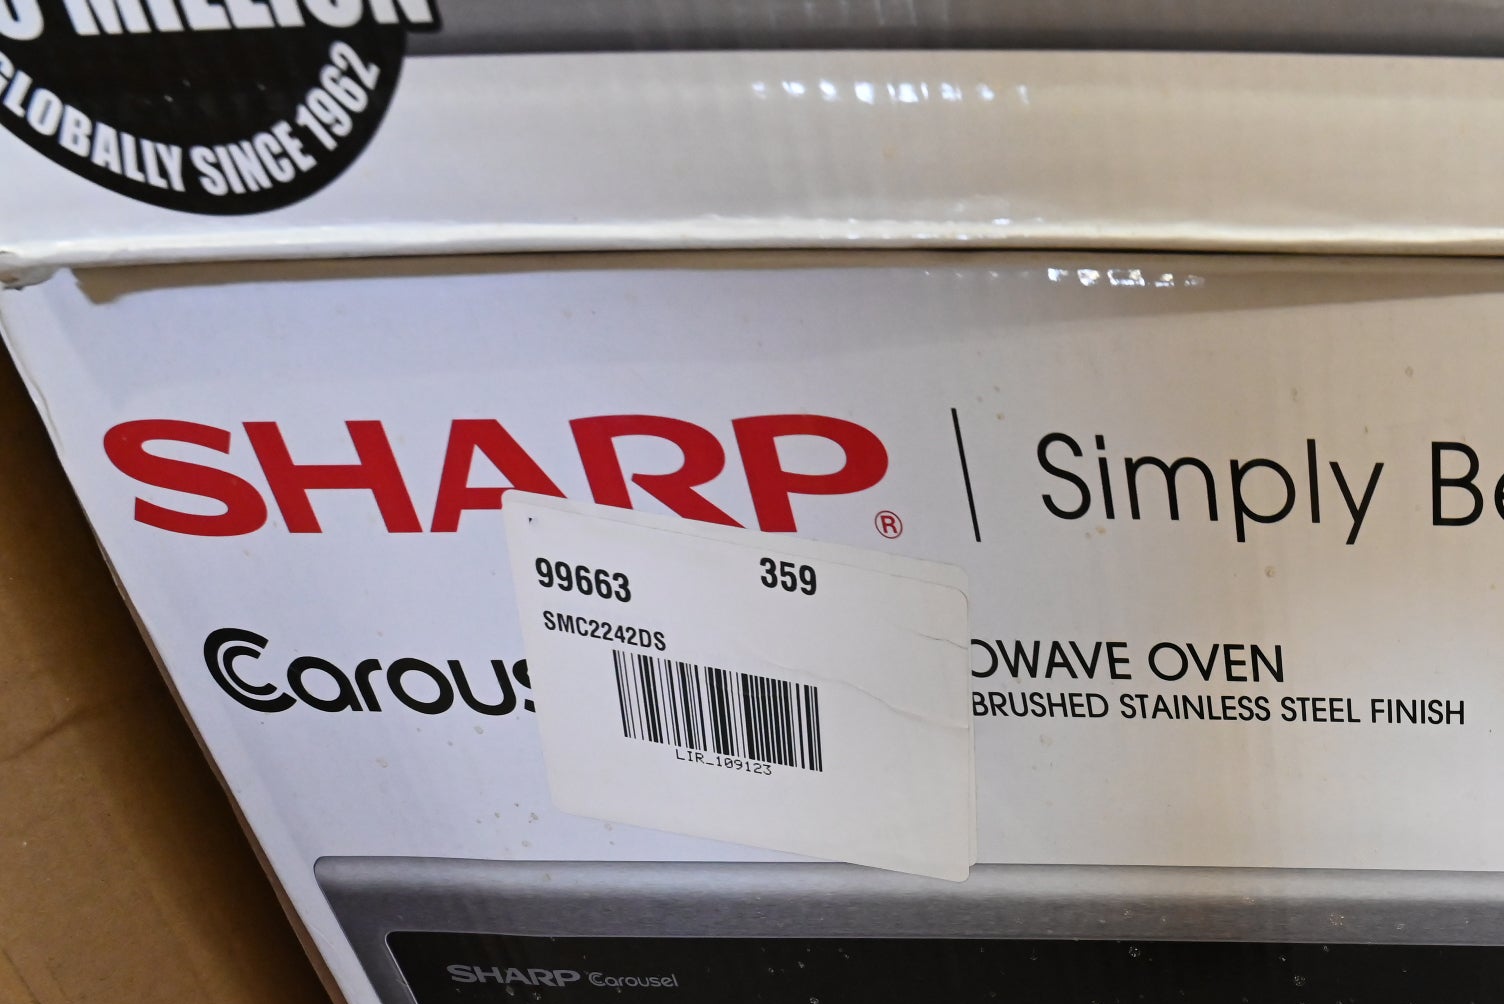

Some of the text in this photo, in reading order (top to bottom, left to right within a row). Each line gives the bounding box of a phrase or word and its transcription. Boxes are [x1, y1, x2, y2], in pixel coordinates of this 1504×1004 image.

[190, 119, 318, 196] SINCE
[295, 40, 381, 151] 1962
[1036, 432, 1385, 545] Simply
[535, 556, 818, 602] 99663 359
[542, 610, 667, 651] SMC2242DS
[1147, 641, 1286, 683] OVEN
[971, 691, 1465, 726] BRUSHED STAINLESS STEEL FINISH
[675, 748, 773, 776] LIR_109123
[447, 964, 679, 988] SHARP Carousel
